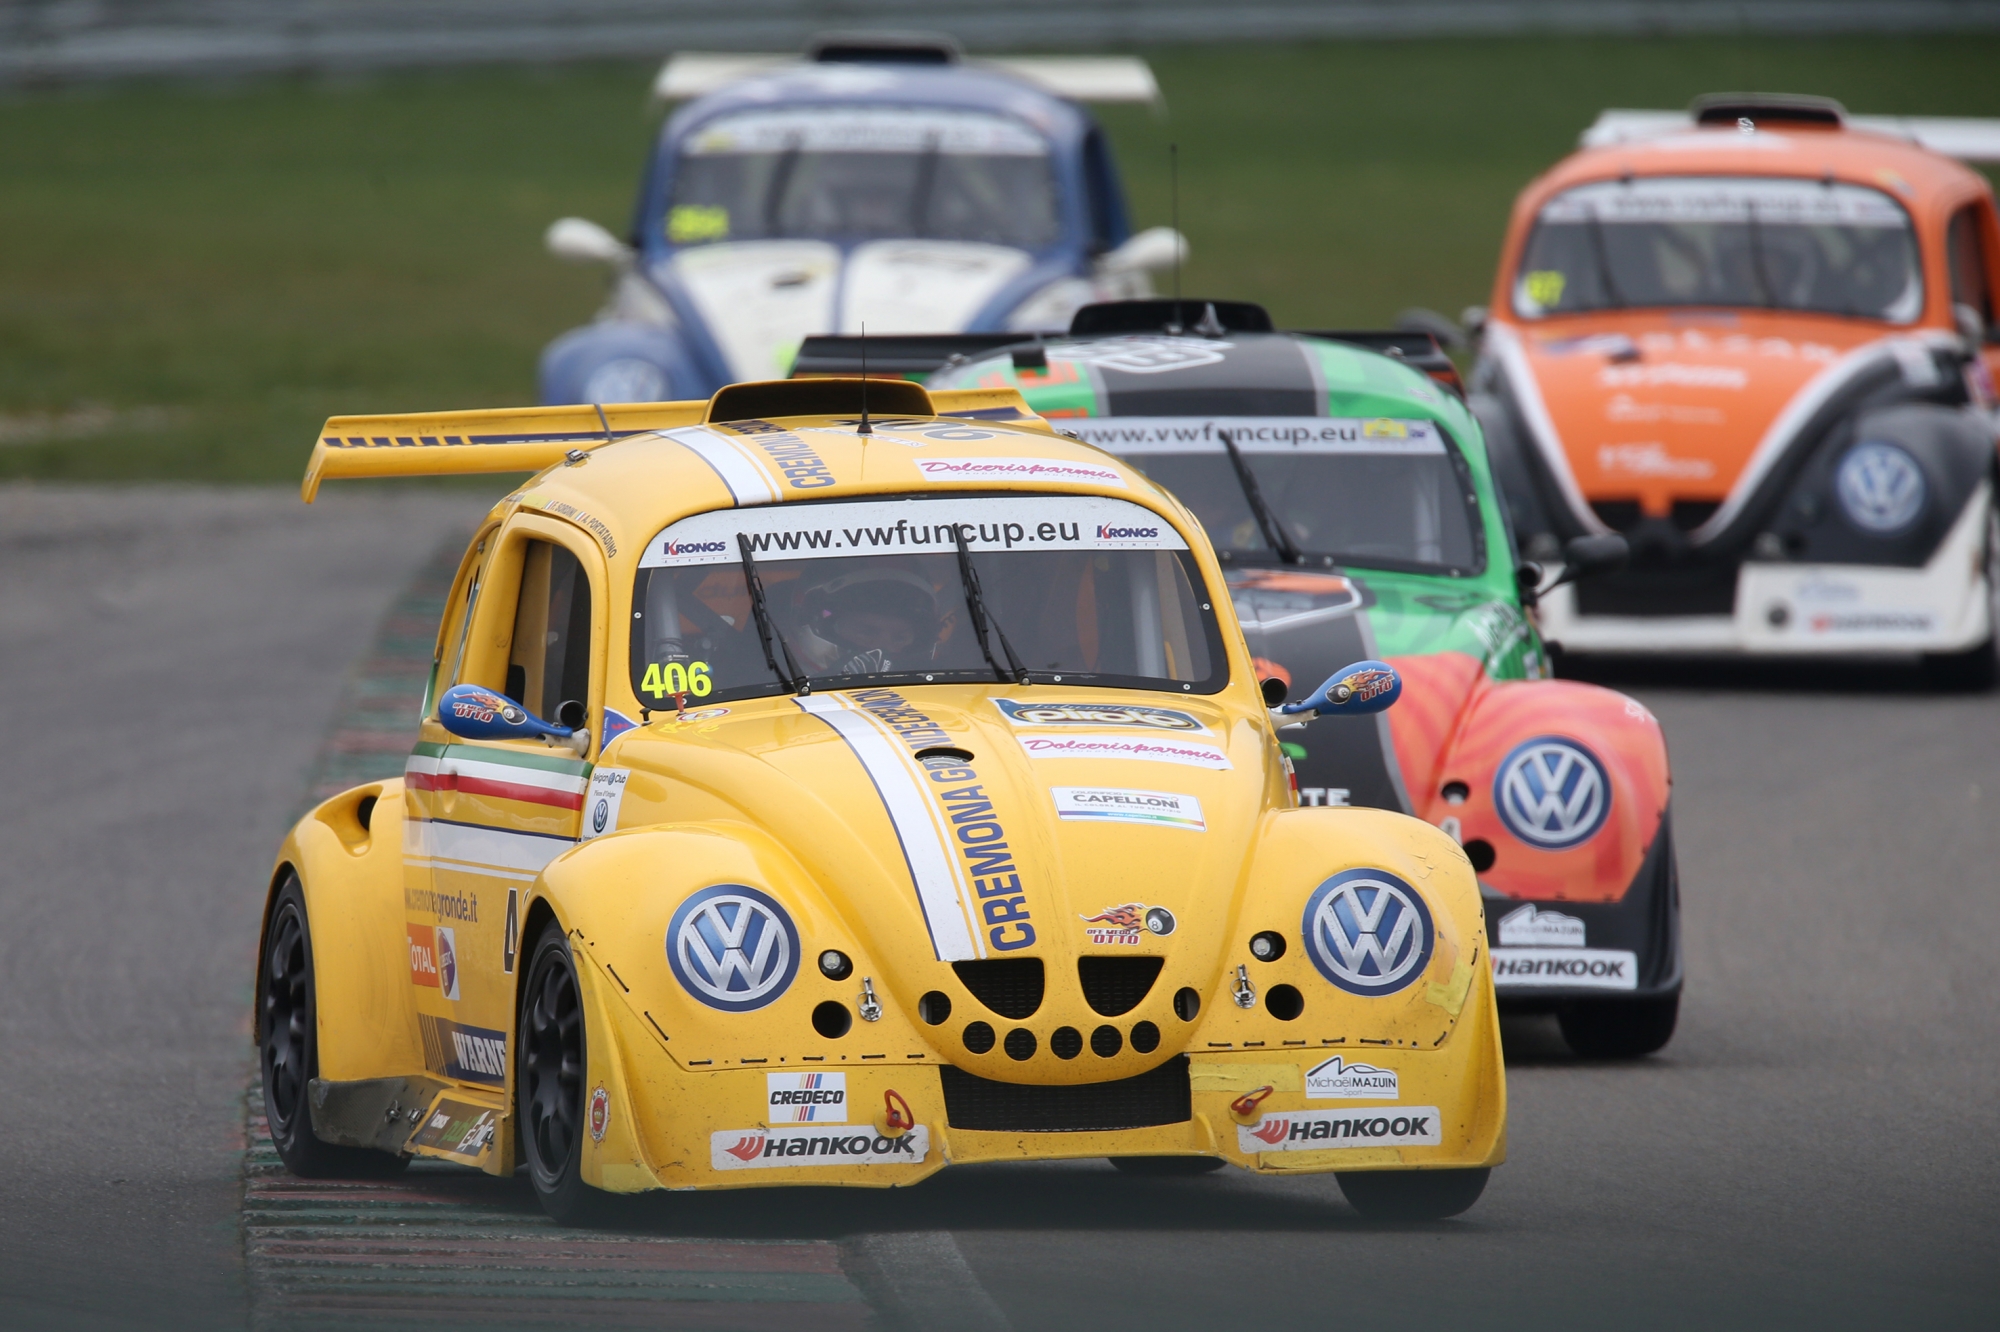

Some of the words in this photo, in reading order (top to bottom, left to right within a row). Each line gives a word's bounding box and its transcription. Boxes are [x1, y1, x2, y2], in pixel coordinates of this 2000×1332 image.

[921, 461, 1121, 480] Dolcerisparmio
[744, 518, 1080, 552] www.vwfuncup.eu
[1097, 521, 1158, 539] KRONOS
[664, 538, 726, 555] KRONOS
[641, 661, 712, 698] 406
[1361, 680, 1392, 701] OTTO
[456, 707, 492, 722] OTTO
[1024, 739, 1225, 761] Dolcerisparmio
[615, 774, 627, 784] Club
[957, 785, 1037, 951] CREMONA
[1094, 935, 1139, 944] OTTO
[770, 1090, 844, 1105] CREDECO
[1344, 1088, 1363, 1097] Sport
